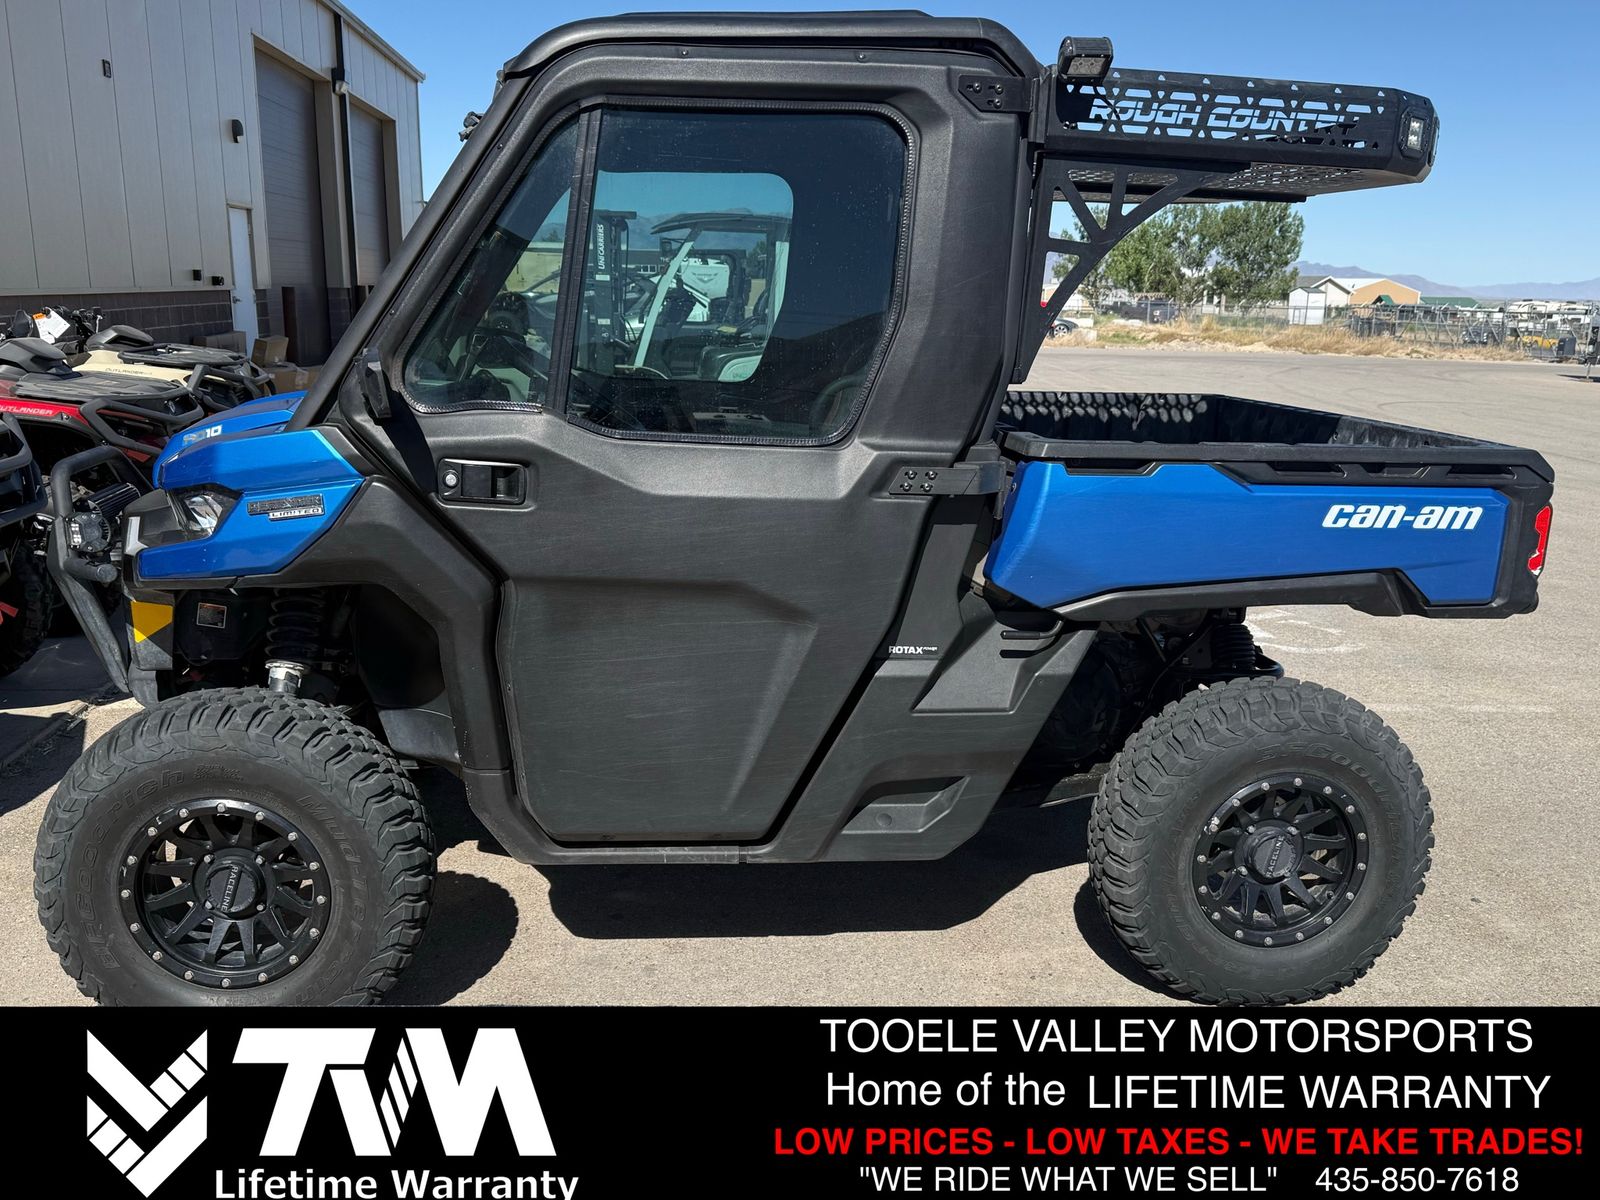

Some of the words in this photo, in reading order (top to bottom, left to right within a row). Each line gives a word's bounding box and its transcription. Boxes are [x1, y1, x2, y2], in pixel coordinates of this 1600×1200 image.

[1089, 98, 1202, 126] ROUGH
[1206, 106, 1360, 136] COUNTRY
[1321, 503, 1483, 530] can-am
[888, 645, 923, 654] ROTAX
[220, 864, 239, 912] RACELINE
